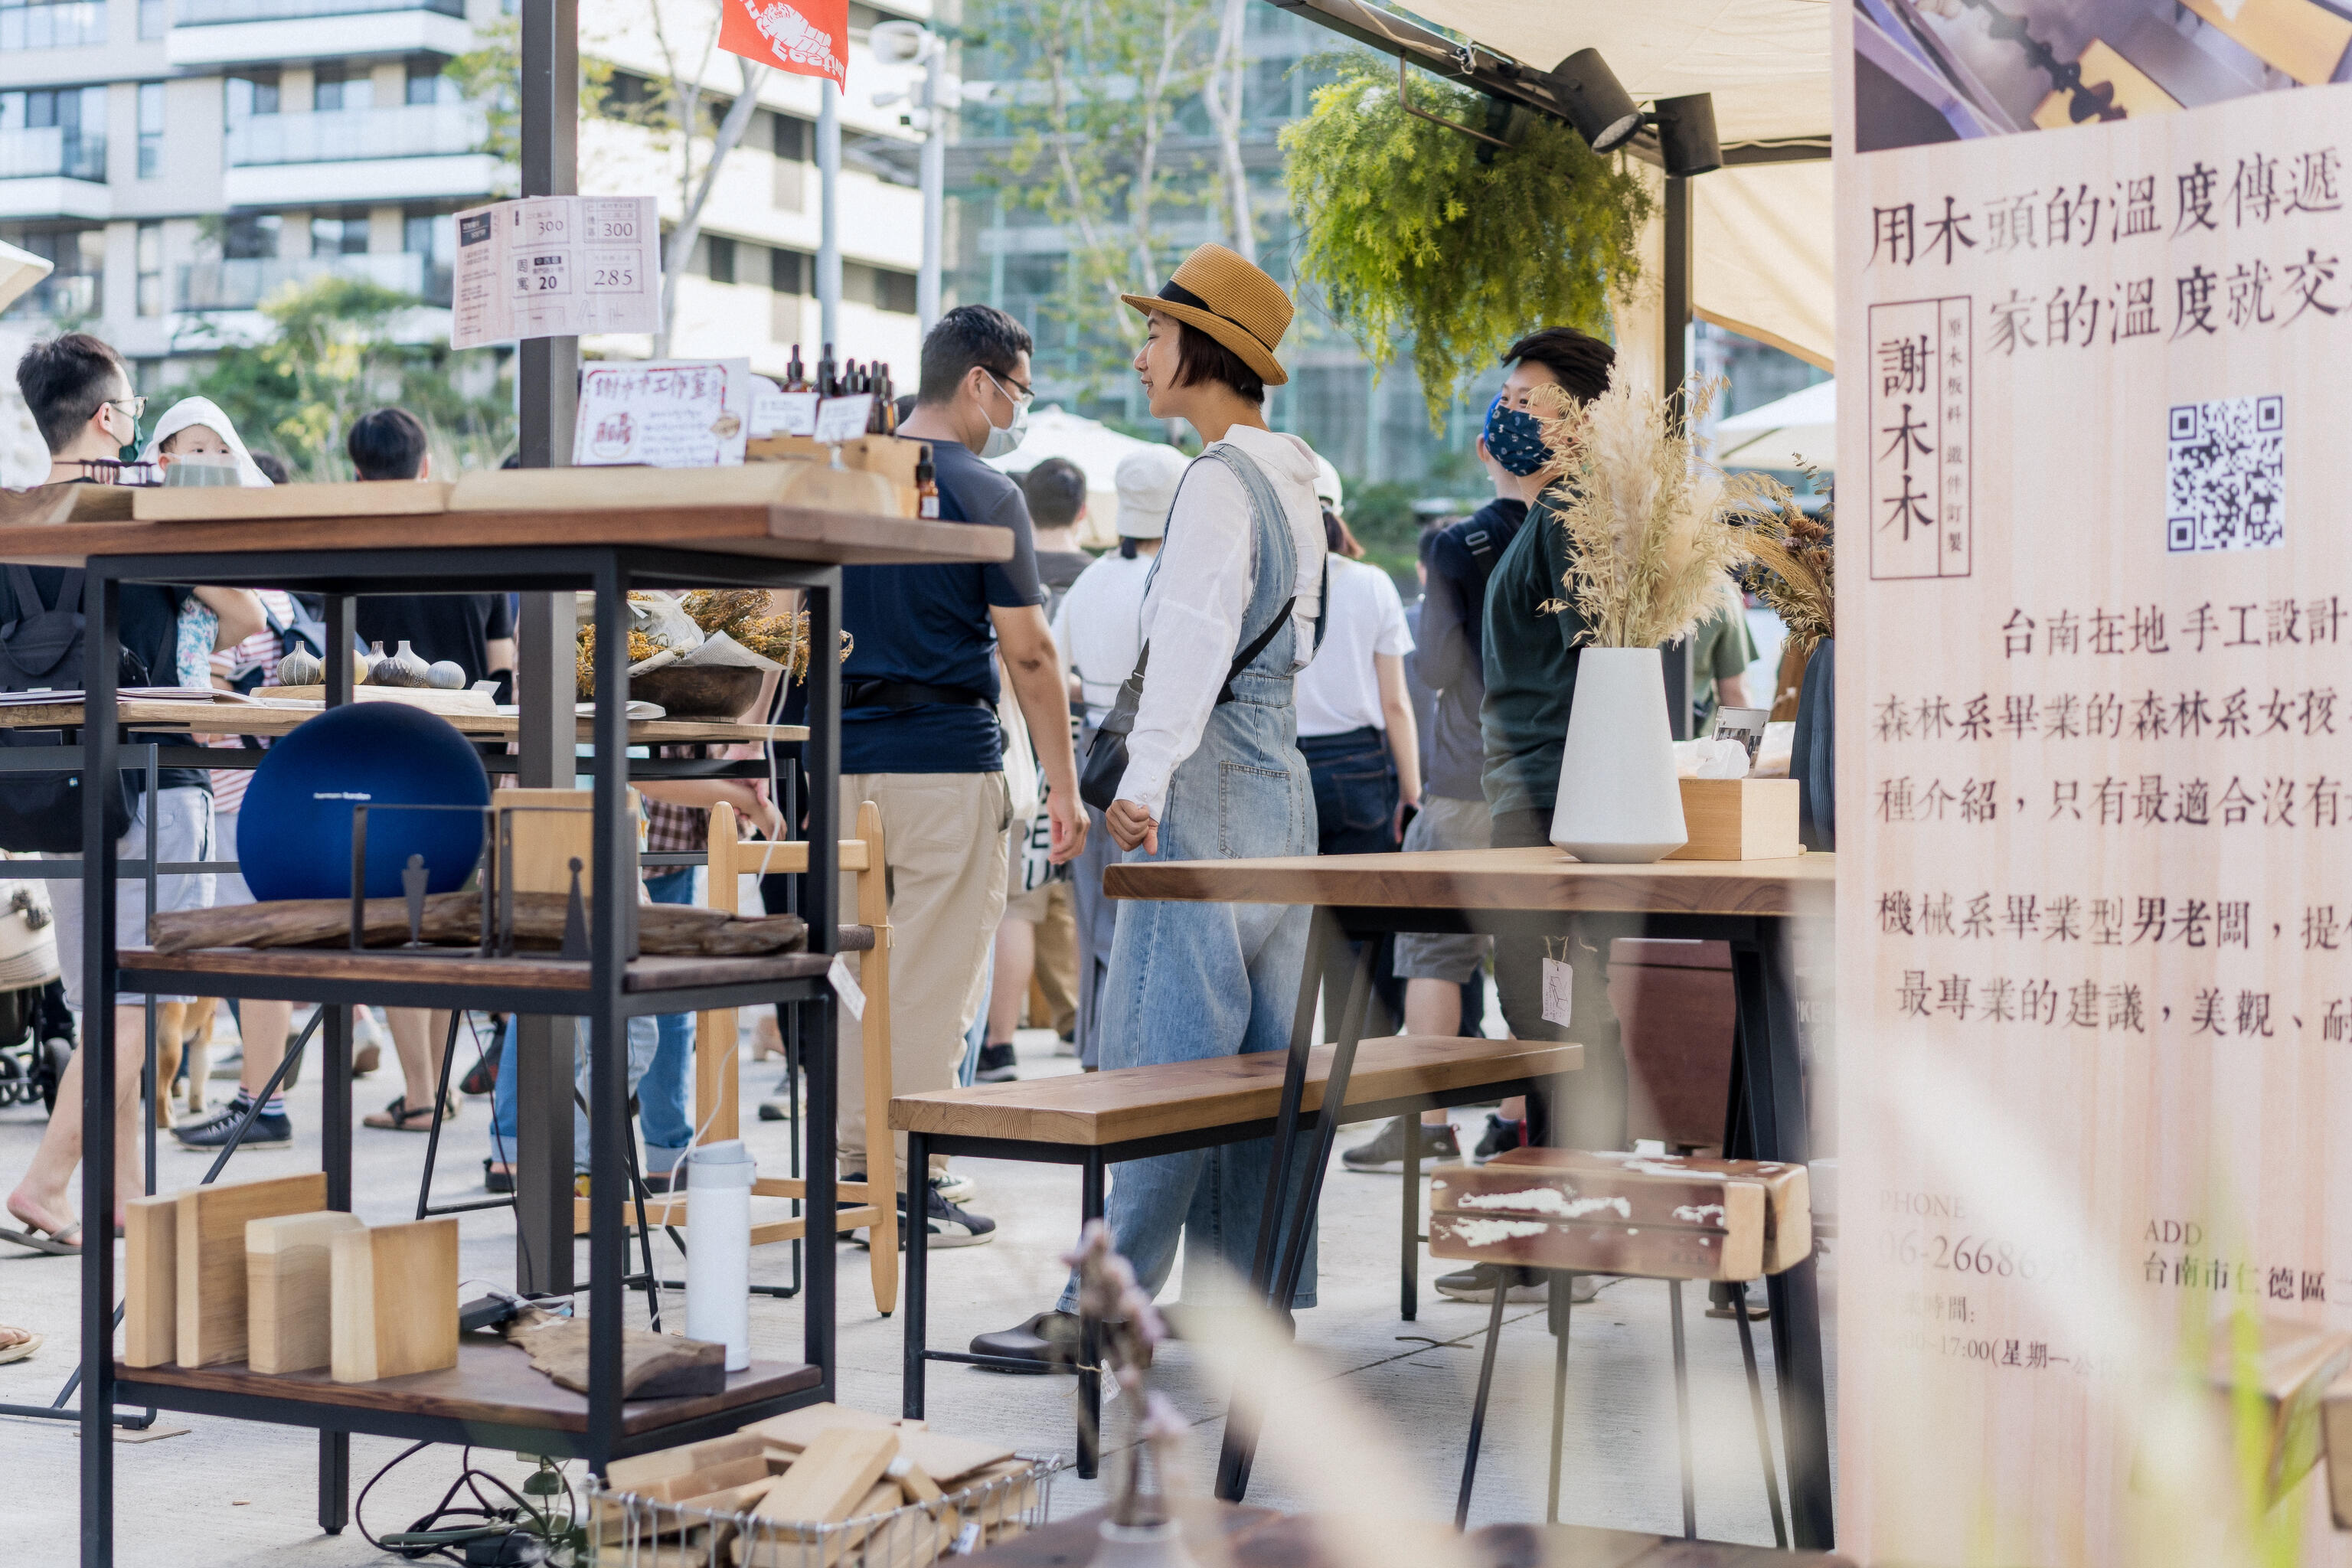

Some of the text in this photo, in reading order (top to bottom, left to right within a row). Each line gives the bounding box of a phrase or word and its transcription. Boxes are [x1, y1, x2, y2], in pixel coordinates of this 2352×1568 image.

[538, 220, 564, 236] 300
[604, 223, 633, 237] 300
[1863, 146, 2344, 273] 用木頭的溫度傳遞
[539, 276, 557, 290] 20
[594, 269, 633, 286] 285
[1984, 247, 2352, 358] 家的溫度就交
[1877, 333, 1936, 542] 謝木木
[1872, 686, 2352, 742] 森林系畢業的森林系女孩
[1874, 774, 2352, 828] 種介紹，只有最適合沒有
[1875, 889, 2352, 951] 機械系畢業型男老闆，提
[1879, 1188, 1967, 1220] PHONE
[2144, 1219, 2203, 1246] ADD
